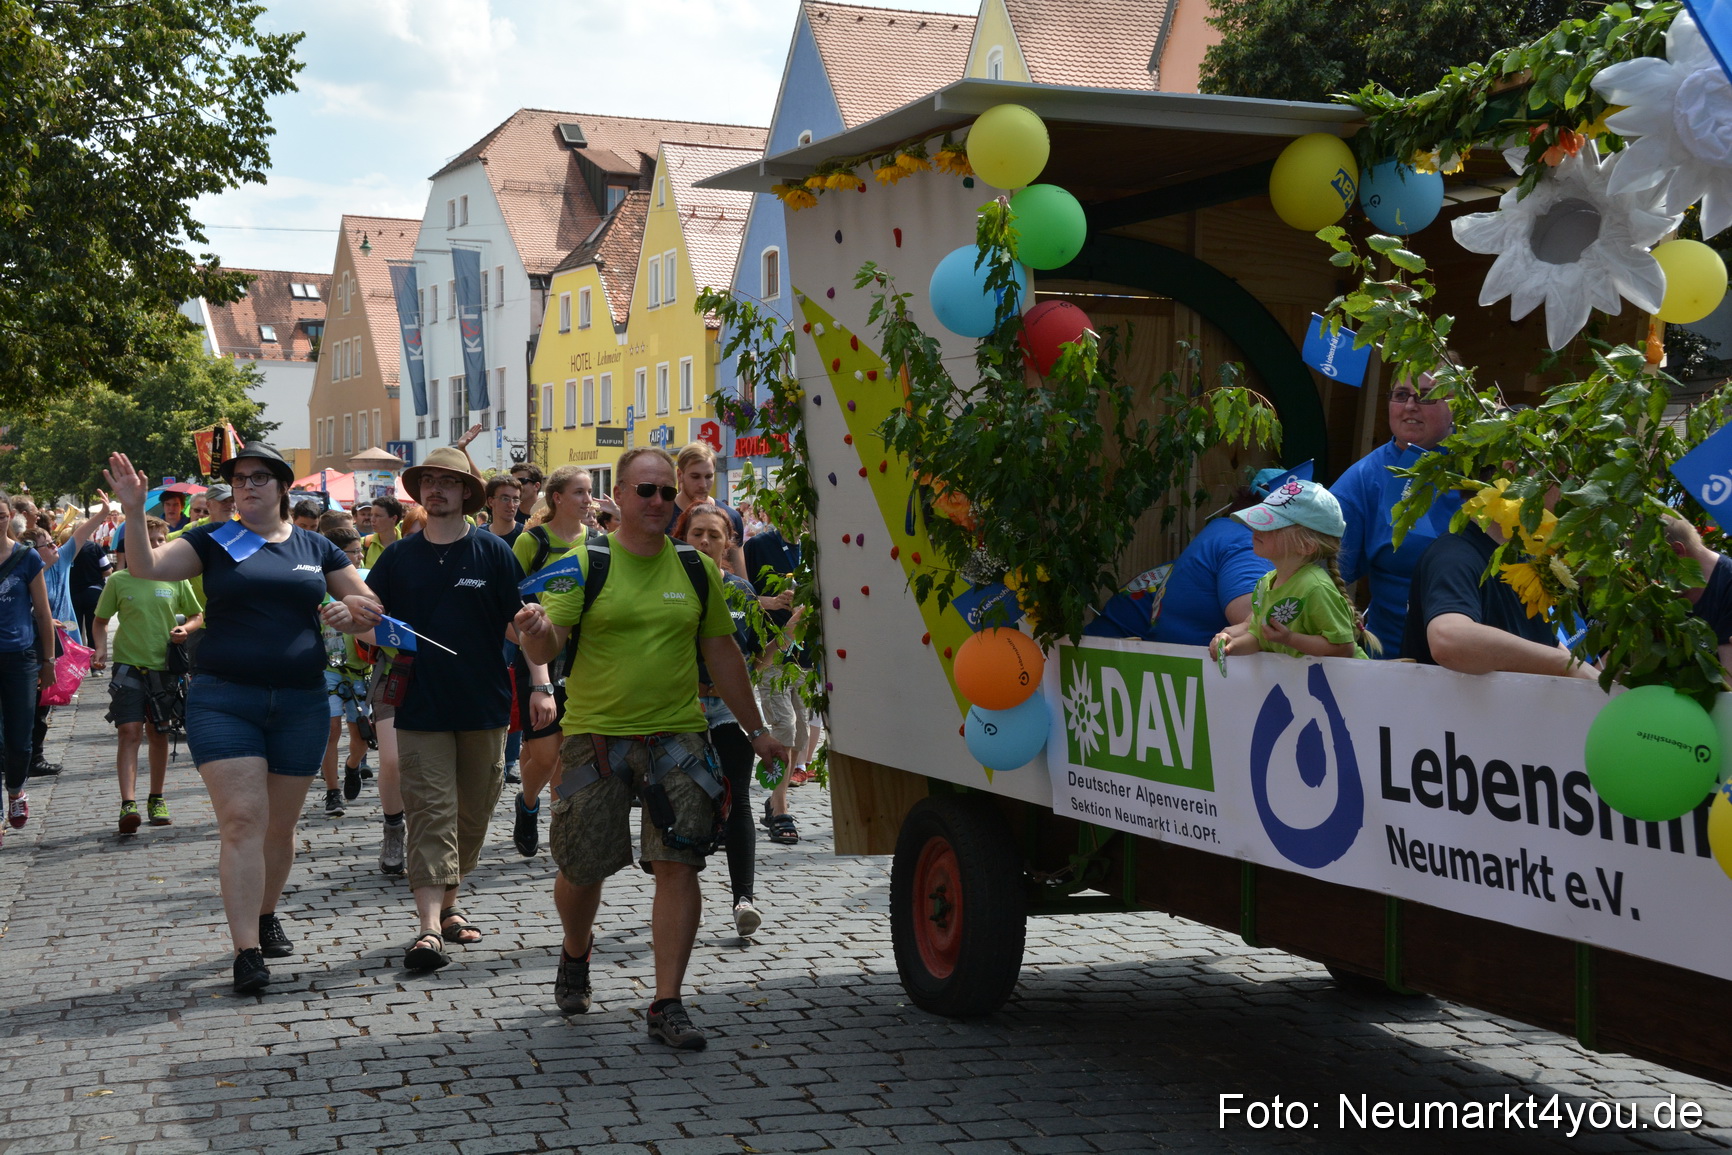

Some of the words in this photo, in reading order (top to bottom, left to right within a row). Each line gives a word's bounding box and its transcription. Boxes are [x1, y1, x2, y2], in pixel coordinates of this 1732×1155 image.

[571, 352, 592, 373] HOTEL
[597, 348, 622, 366] Lehmeier
[597, 438, 623, 446] TAIFUN
[648, 429, 669, 443] TAIFN
[569, 448, 599, 462] Restaurant
[669, 591, 686, 600] DAV
[982, 587, 1010, 611] Lebenshi
[1101, 666, 1198, 770] DAV
[1636, 730, 1693, 753] Lebenshilfe
[1068, 771, 1131, 798] Deutscher
[1136, 785, 1218, 817] Alpenverein
[1071, 796, 1112, 819] Sektion
[1115, 807, 1170, 833] Neumarkt
[1174, 819, 1221, 844] i.d.OPf.
[1385, 824, 1556, 903] Neumarkt
[1565, 867, 1641, 921] e.V.
